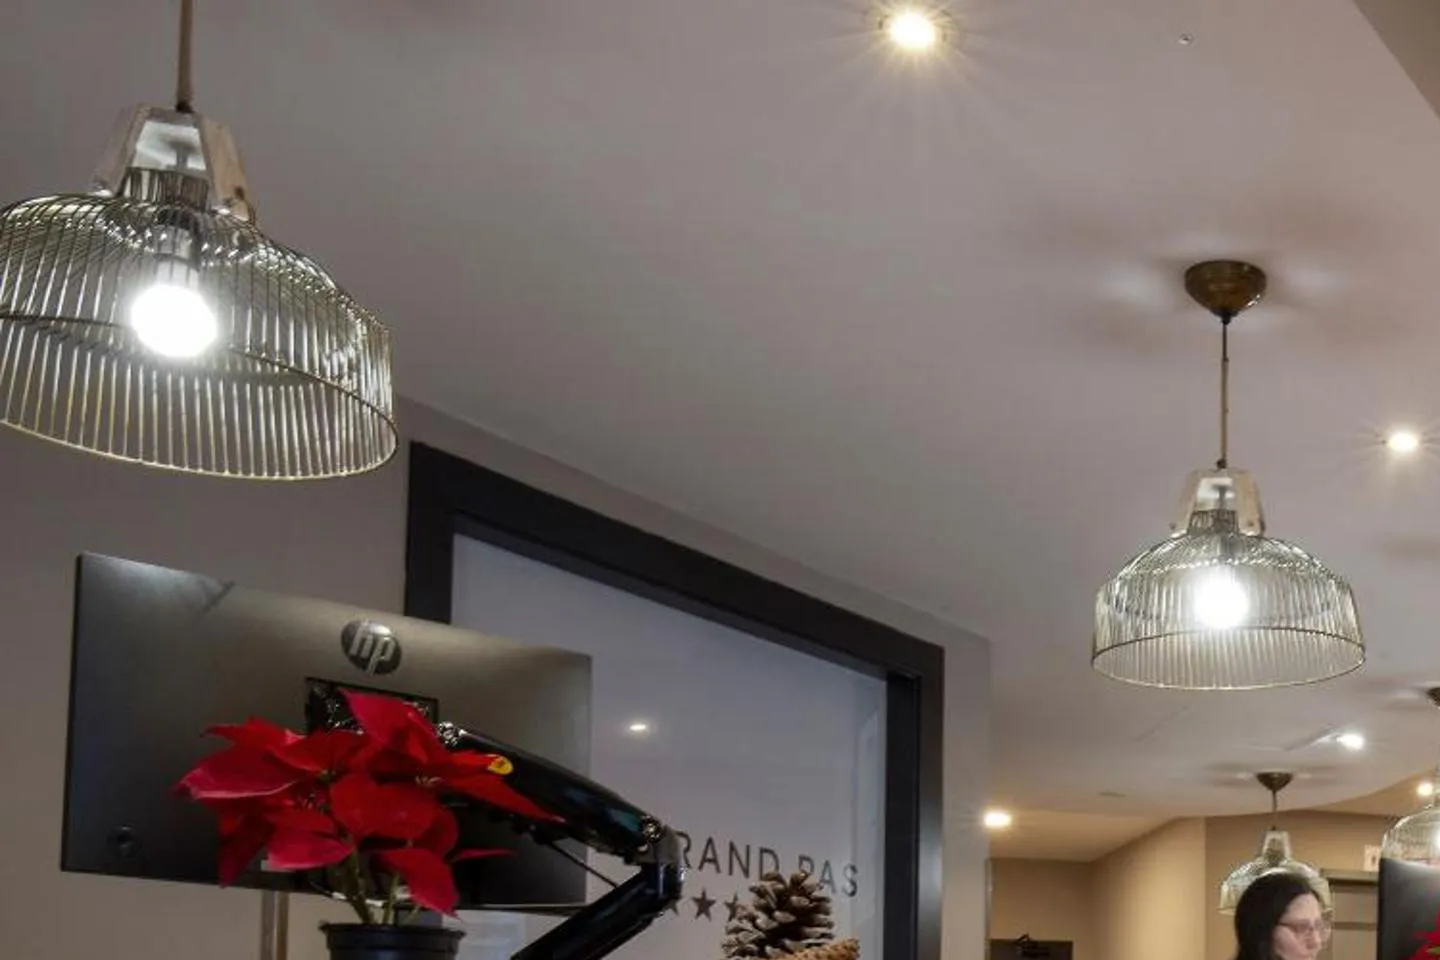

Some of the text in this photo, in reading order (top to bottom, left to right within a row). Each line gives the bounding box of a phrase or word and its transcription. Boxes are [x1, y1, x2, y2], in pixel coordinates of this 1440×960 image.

[347, 619, 397, 677] hp
[675, 830, 859, 898] RAND PAS
